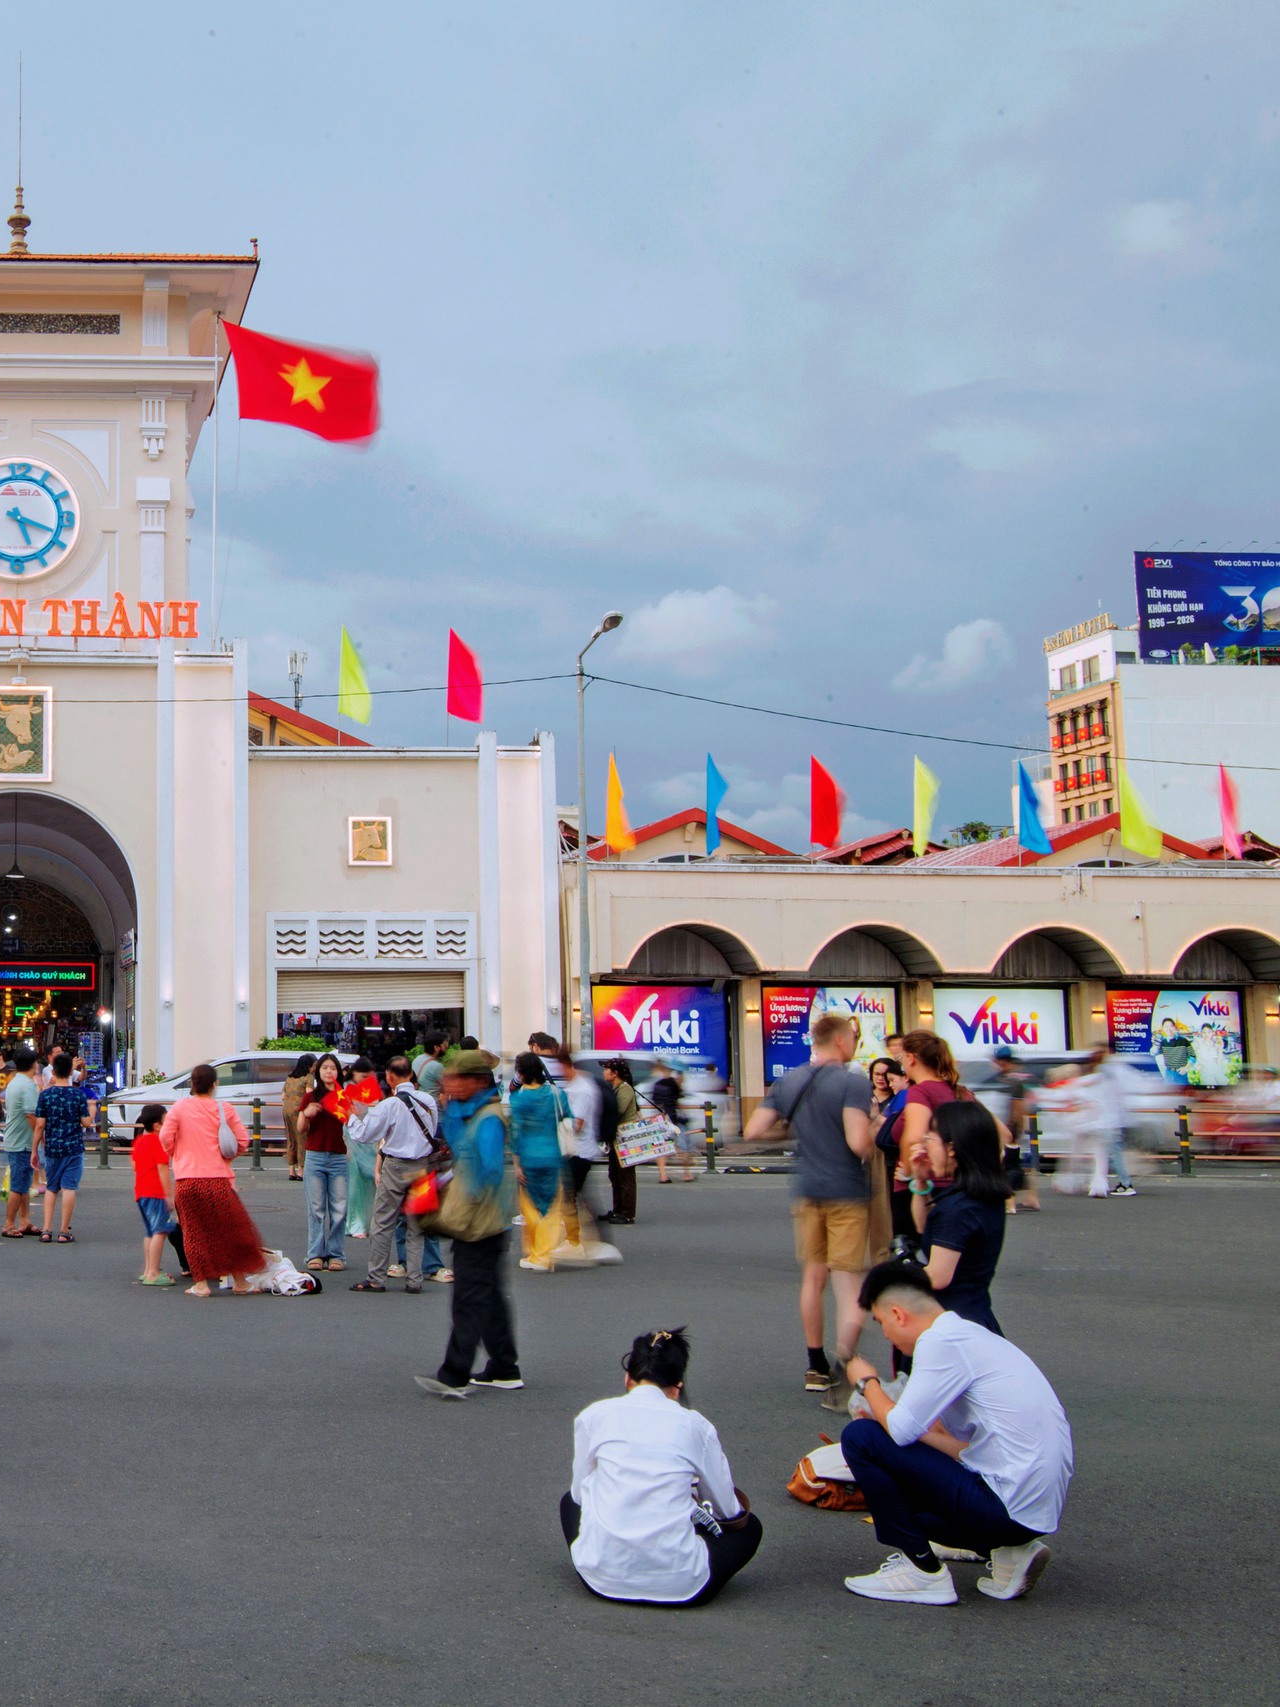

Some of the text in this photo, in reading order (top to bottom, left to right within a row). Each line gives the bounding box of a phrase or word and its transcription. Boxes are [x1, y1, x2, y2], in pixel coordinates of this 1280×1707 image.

[8, 463, 32, 480] 12
[10, 558, 25, 574] 6
[1163, 589, 1187, 599] PHONG
[42, 591, 200, 638] THÀNH
[1148, 602, 1172, 613] KHÔNG
[1189, 603, 1204, 612] HẠN
[1076, 612, 1114, 640] HOTEL
[1148, 618, 1165, 629] 1996
[1177, 615, 1194, 625] 2026
[0, 970, 18, 979] KÍNH
[42, 971, 58, 979] QUÝ
[59, 971, 86, 980] KHÁCH
[844, 991, 885, 1013] Vikki
[1188, 993, 1230, 1016] Vikki
[610, 993, 699, 1044] Vikki
[770, 1014, 788, 1023] 0%
[949, 996, 1039, 1044] Vikki
